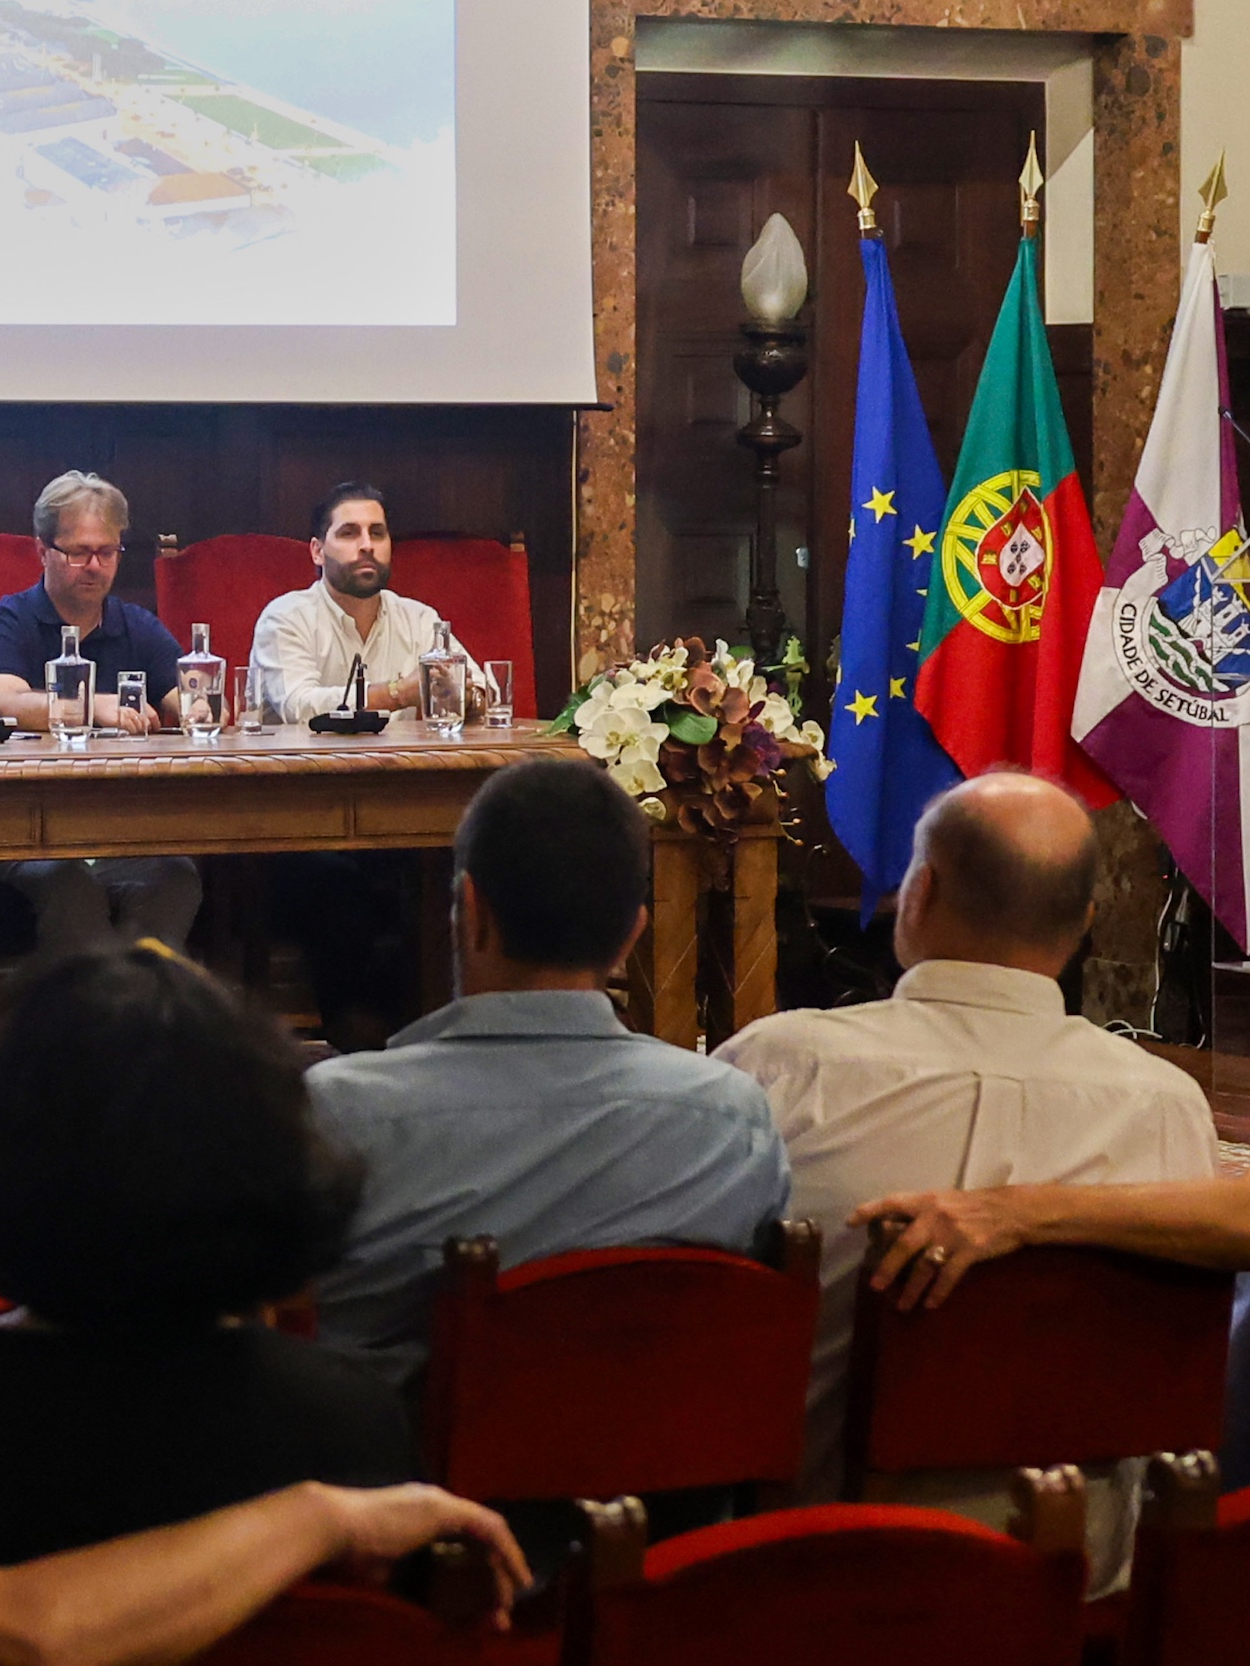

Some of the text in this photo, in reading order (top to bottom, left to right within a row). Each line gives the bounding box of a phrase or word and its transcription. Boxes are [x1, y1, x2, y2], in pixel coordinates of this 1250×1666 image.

[1119, 603, 1230, 722] CIDADE DE SETÚBAL
